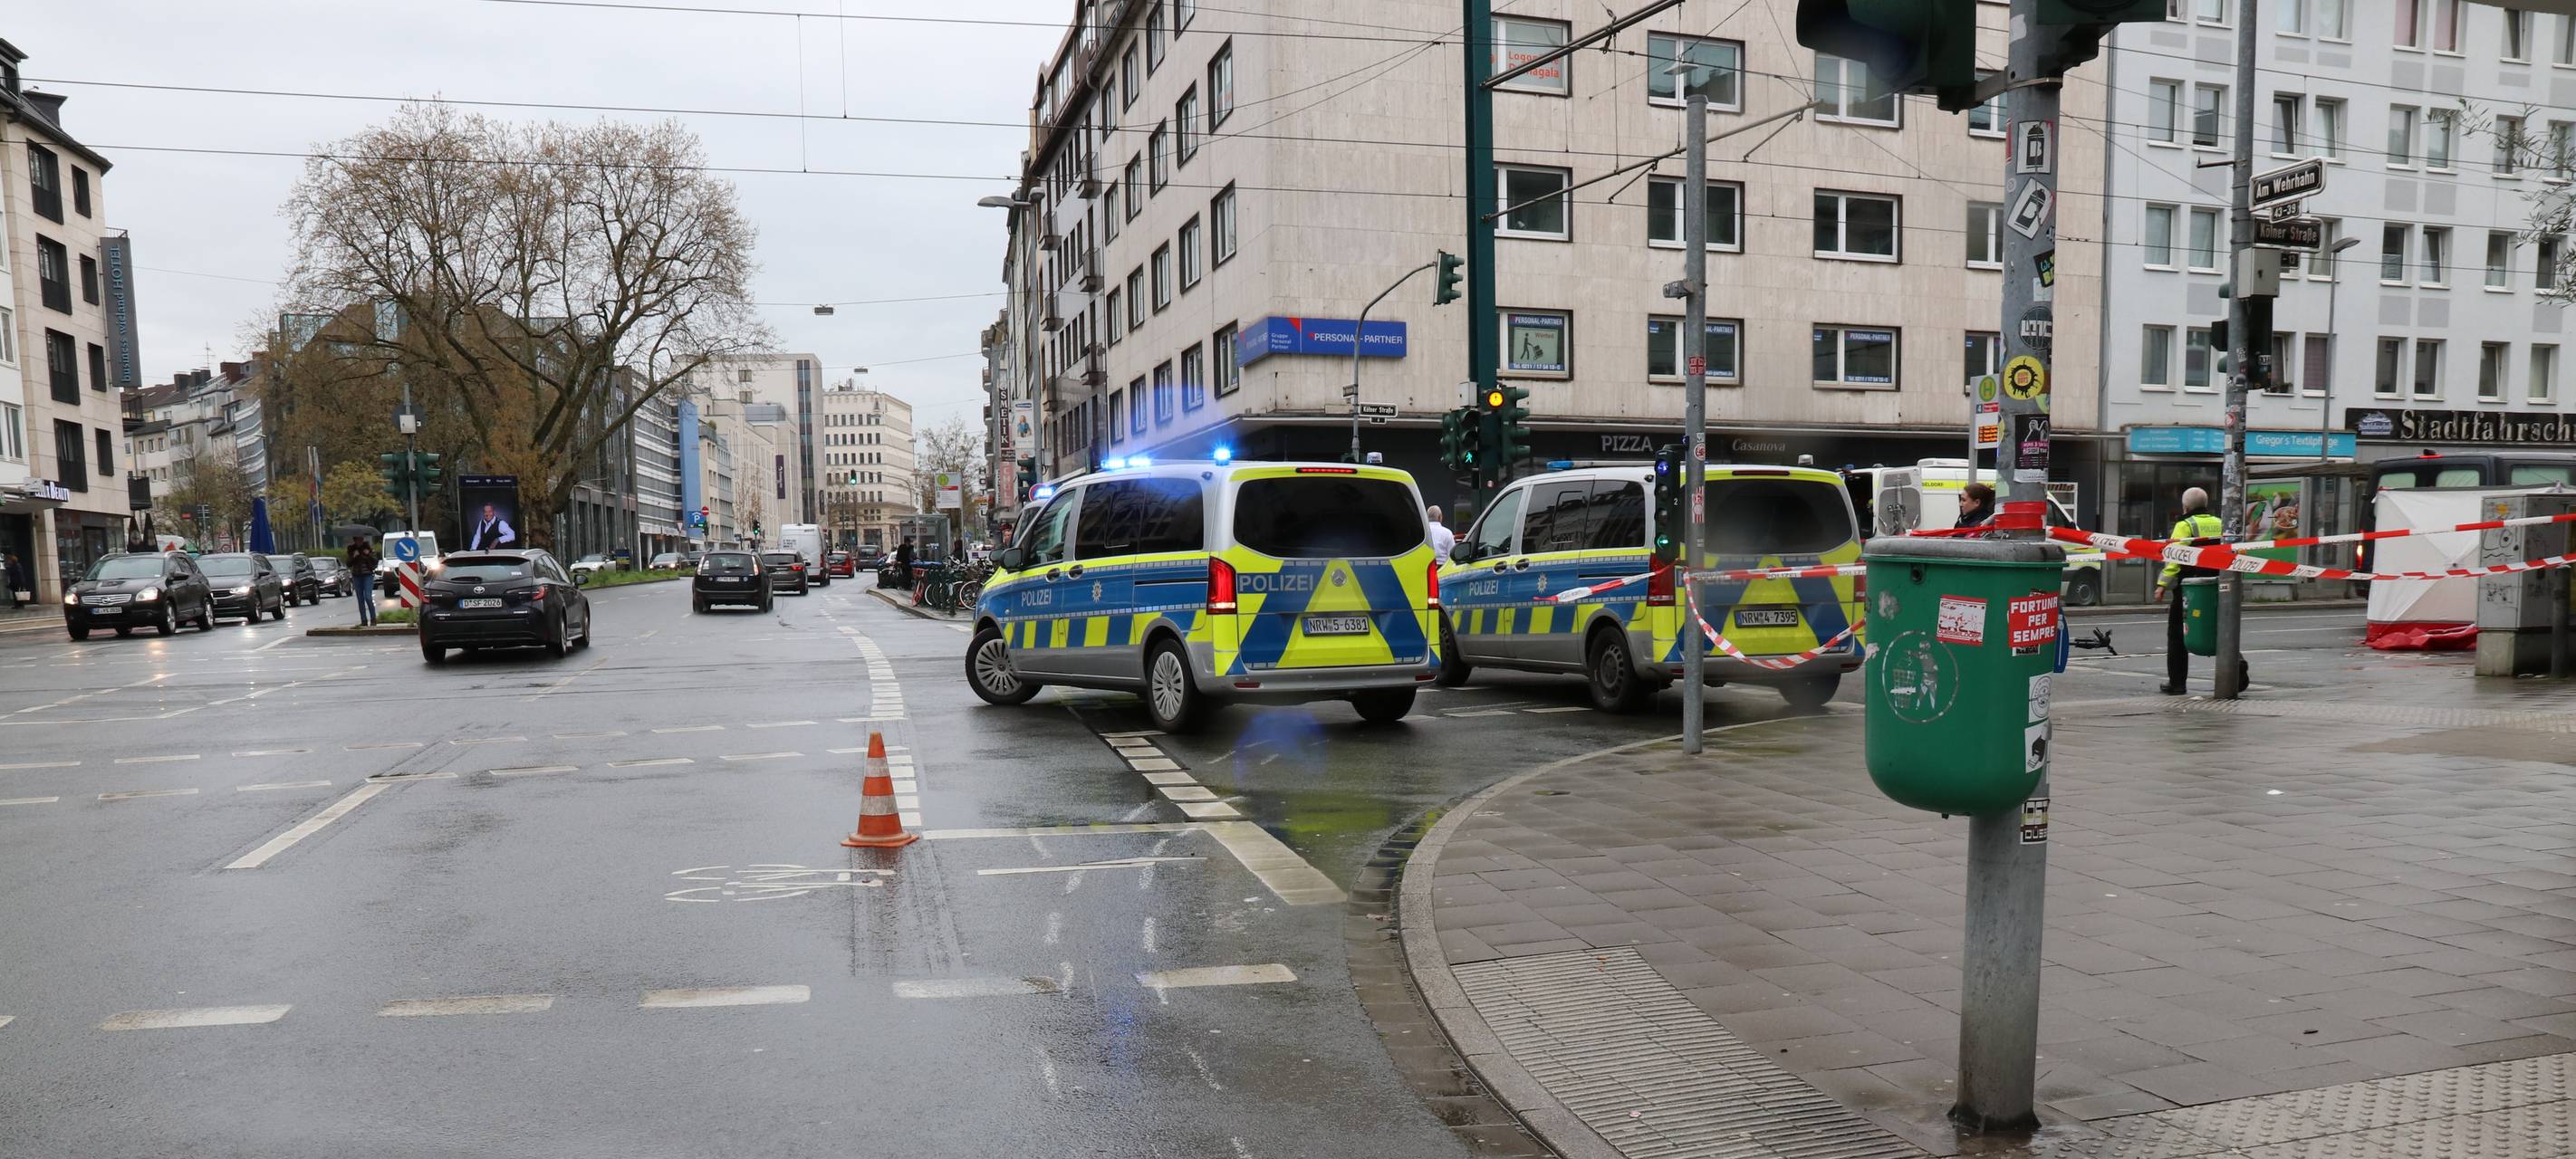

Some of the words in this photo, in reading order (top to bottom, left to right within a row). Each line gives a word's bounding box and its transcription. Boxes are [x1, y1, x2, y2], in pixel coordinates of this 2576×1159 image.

[2256, 184, 2269, 198] Am
[2273, 171, 2315, 194] Wehrhahn
[2274, 204, 2296, 217] 43-39
[2260, 223, 2286, 239] Kölner
[2290, 225, 2317, 244] Straße
[110, 244, 123, 290] HOTEL
[1313, 332, 1403, 344] PERSONA-PARTNER
[120, 338, 131, 383] business
[2399, 409, 2576, 442] Stadtfahrsch
[1600, 436, 1654, 452] PIZZA
[1732, 438, 1786, 452] Casanova
[2255, 434, 2290, 447] Gregor's
[1239, 574, 1313, 591] POLIZEI
[1469, 580, 1499, 595] POLIZEI
[1021, 589, 1052, 607] POLIZEI
[2011, 596, 2058, 614] FORTUNA
[1309, 618, 1328, 631] NRW
[1333, 617, 1369, 631] 5-6381
[1742, 611, 1760, 624] NRW
[1764, 611, 1797, 623] 4-7395
[2028, 613, 2047, 627] PER
[2014, 626, 2055, 643] SEMPRE
